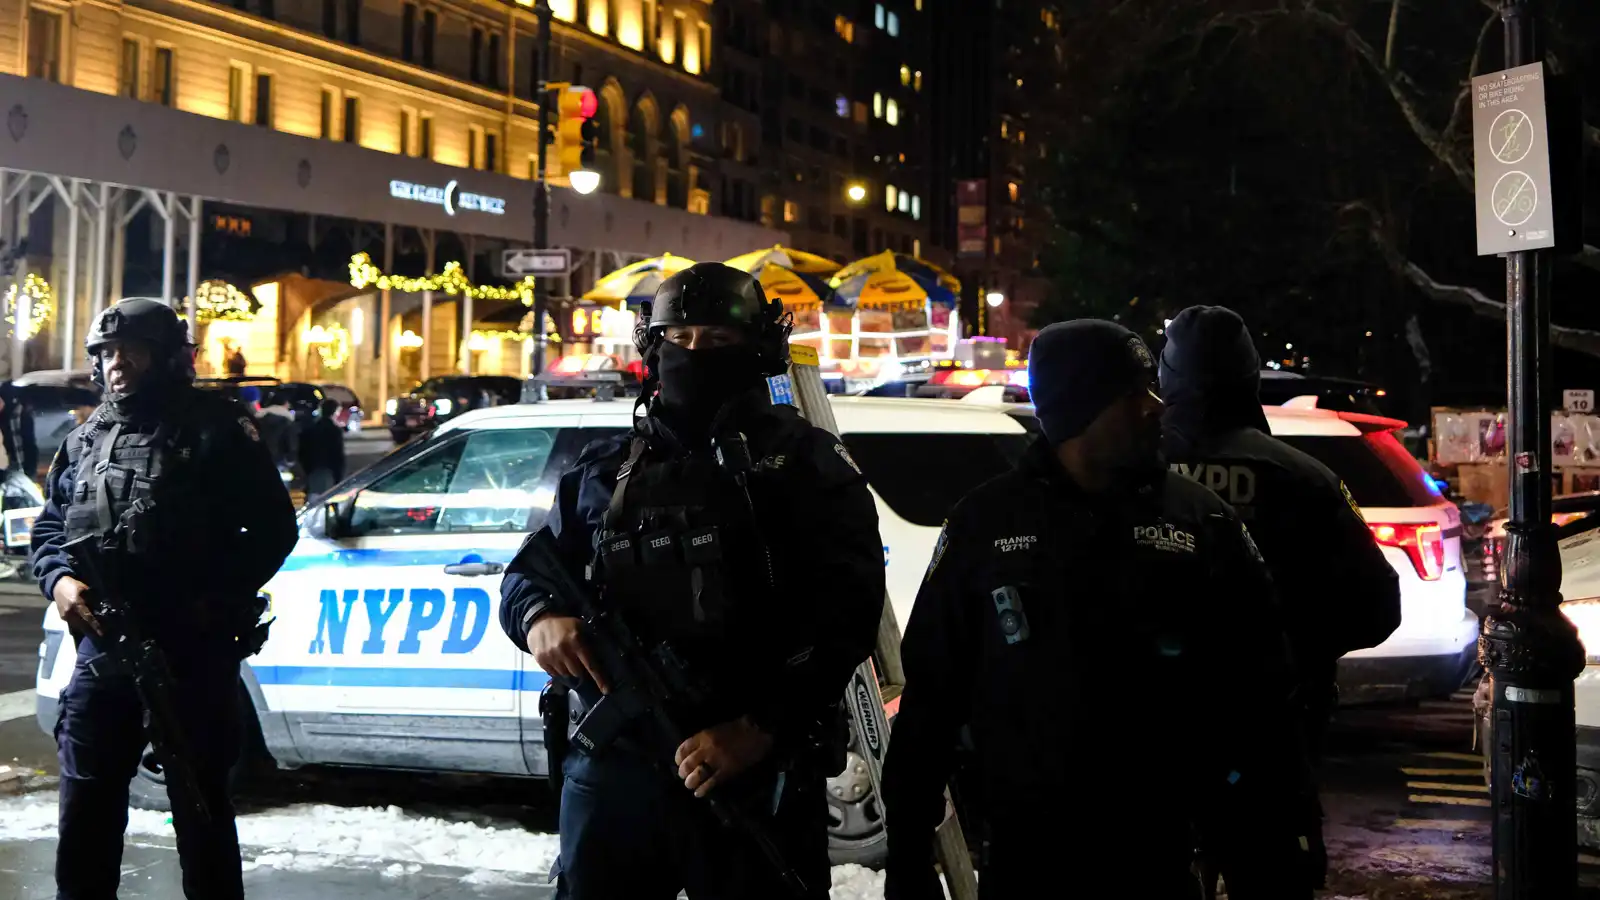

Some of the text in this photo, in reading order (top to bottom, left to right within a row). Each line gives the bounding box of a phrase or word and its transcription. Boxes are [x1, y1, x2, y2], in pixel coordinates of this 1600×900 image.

[1478, 84, 1488, 93] NO
[1478, 84, 1525, 101] OR BIKE RIDING
[1478, 94, 1519, 109] IN THIS AREA
[1168, 462, 1256, 504] YPD
[993, 535, 1038, 548] FRANKS
[1133, 525, 1196, 549] POLICE
[308, 587, 491, 654] NYPD
[859, 690, 877, 744] WERNER
